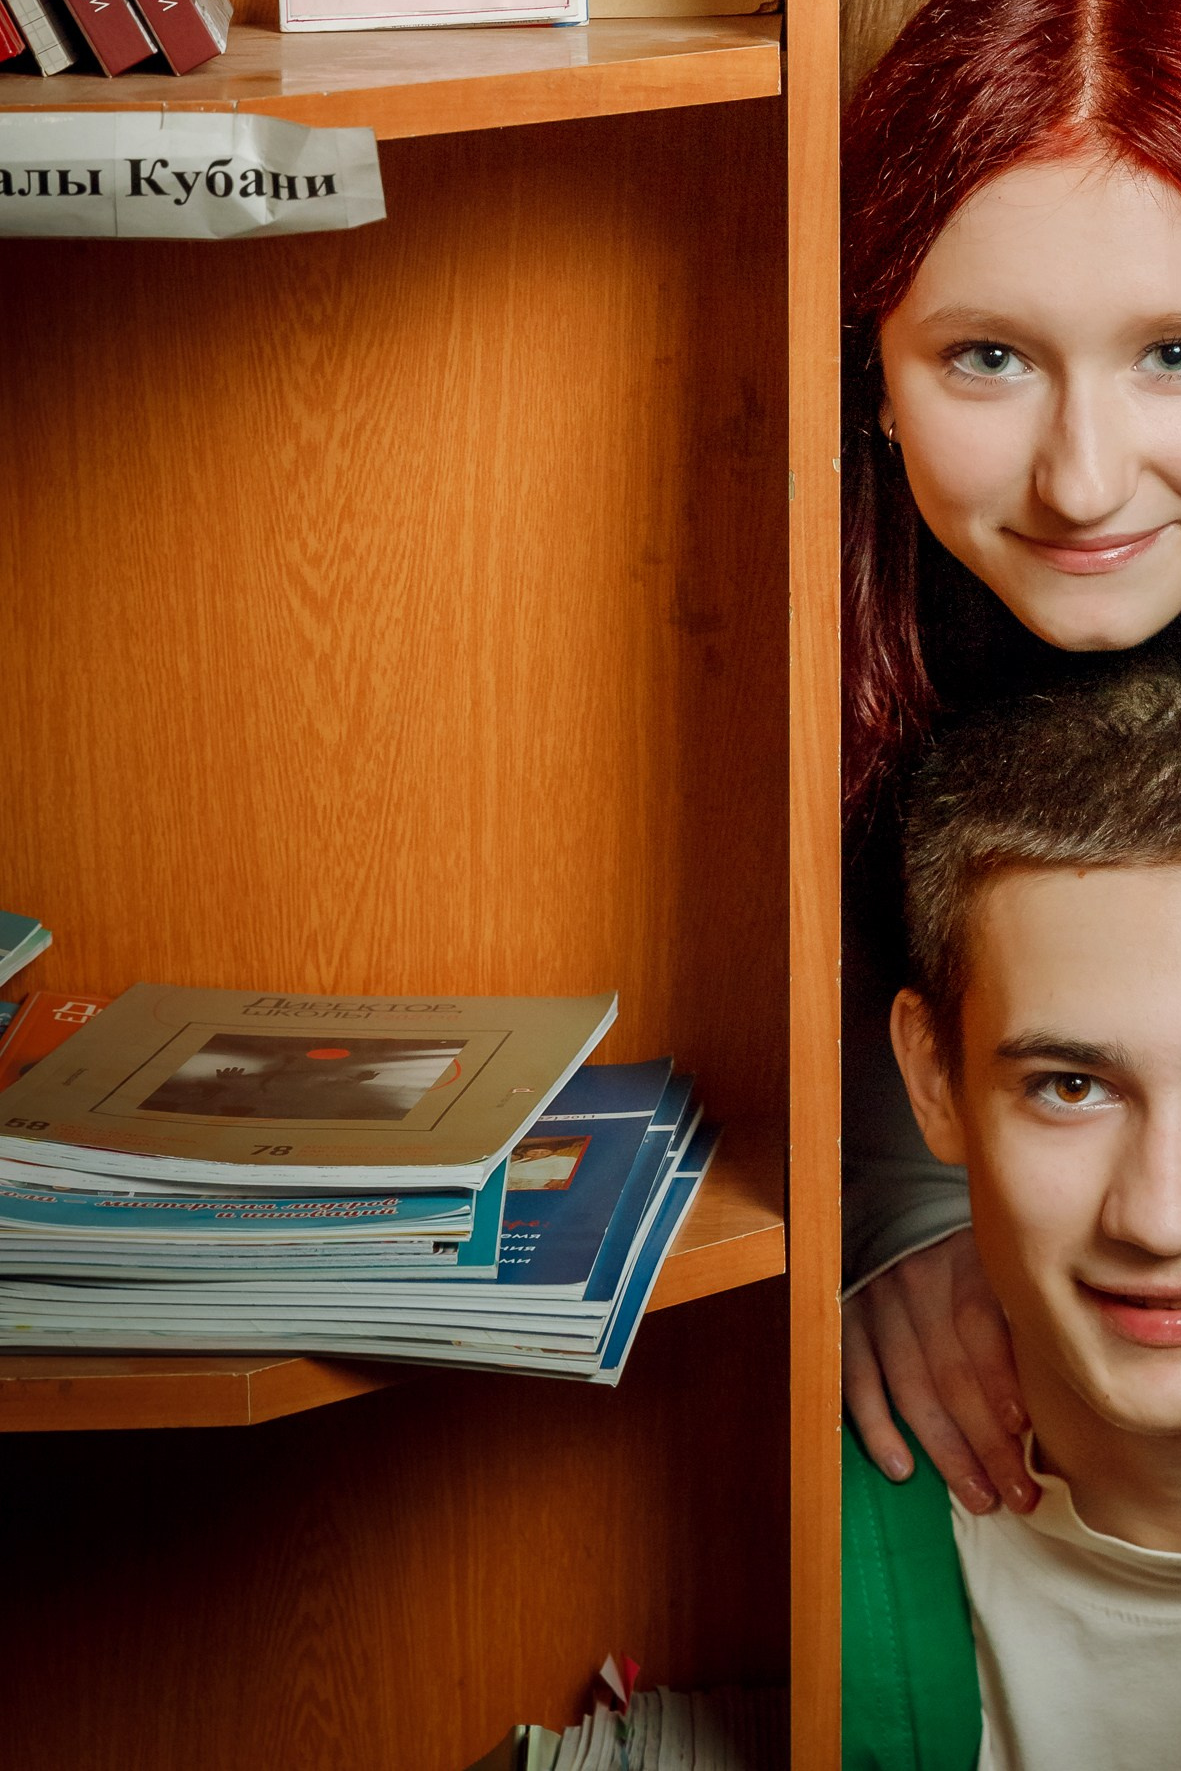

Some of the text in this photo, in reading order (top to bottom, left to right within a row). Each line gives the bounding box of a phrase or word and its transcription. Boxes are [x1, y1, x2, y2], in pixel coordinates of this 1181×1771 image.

[125, 157, 339, 206] Кубани
[4, 1117, 50, 1132] 58
[250, 1144, 294, 1157] 78
[94, 1197, 276, 1213] мастерская
[281, 1195, 402, 1212] лидеров
[215, 1205, 399, 1221] и инноваций
